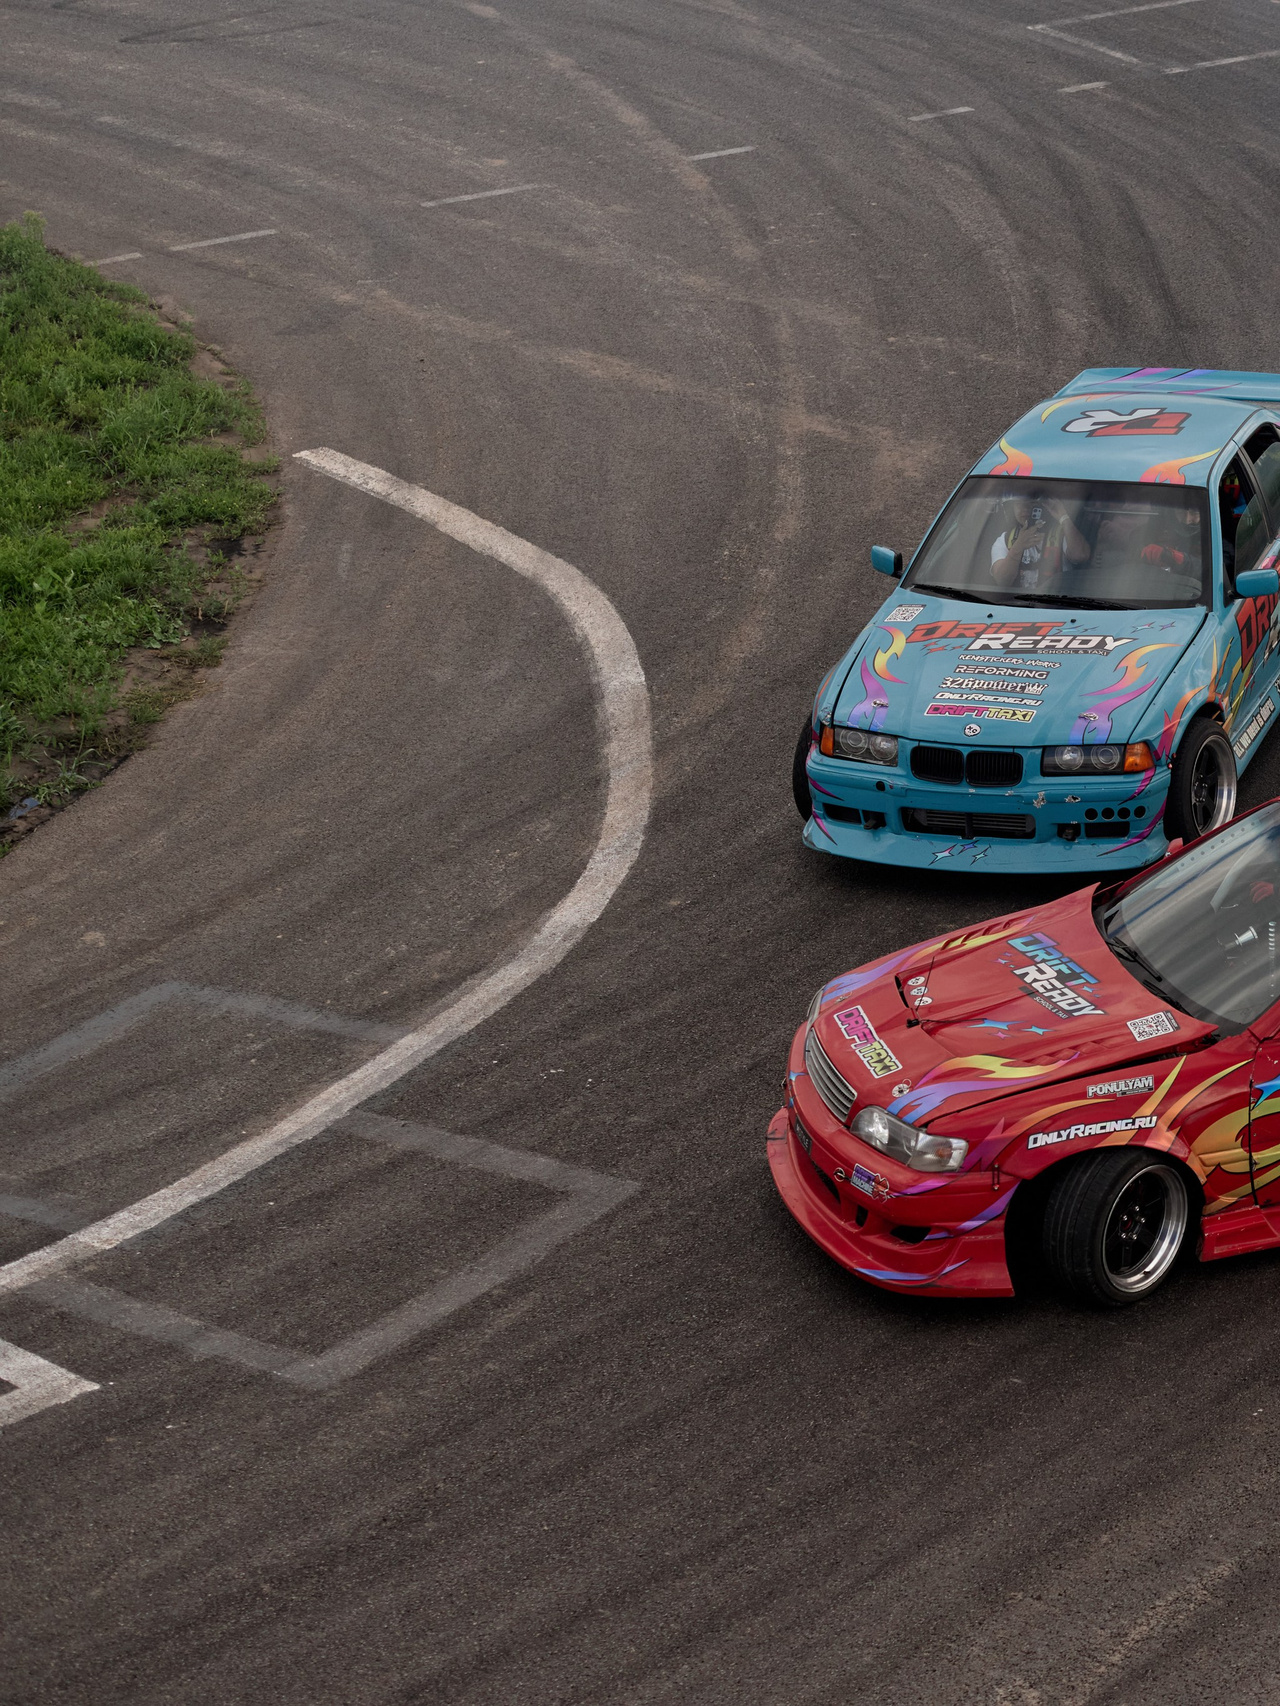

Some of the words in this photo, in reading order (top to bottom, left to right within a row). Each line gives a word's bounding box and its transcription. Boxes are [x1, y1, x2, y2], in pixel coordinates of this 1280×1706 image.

[967, 634, 1138, 651] READY
[1013, 962, 1107, 1017] READY
[1087, 1075, 1154, 1098] PONULYAM
